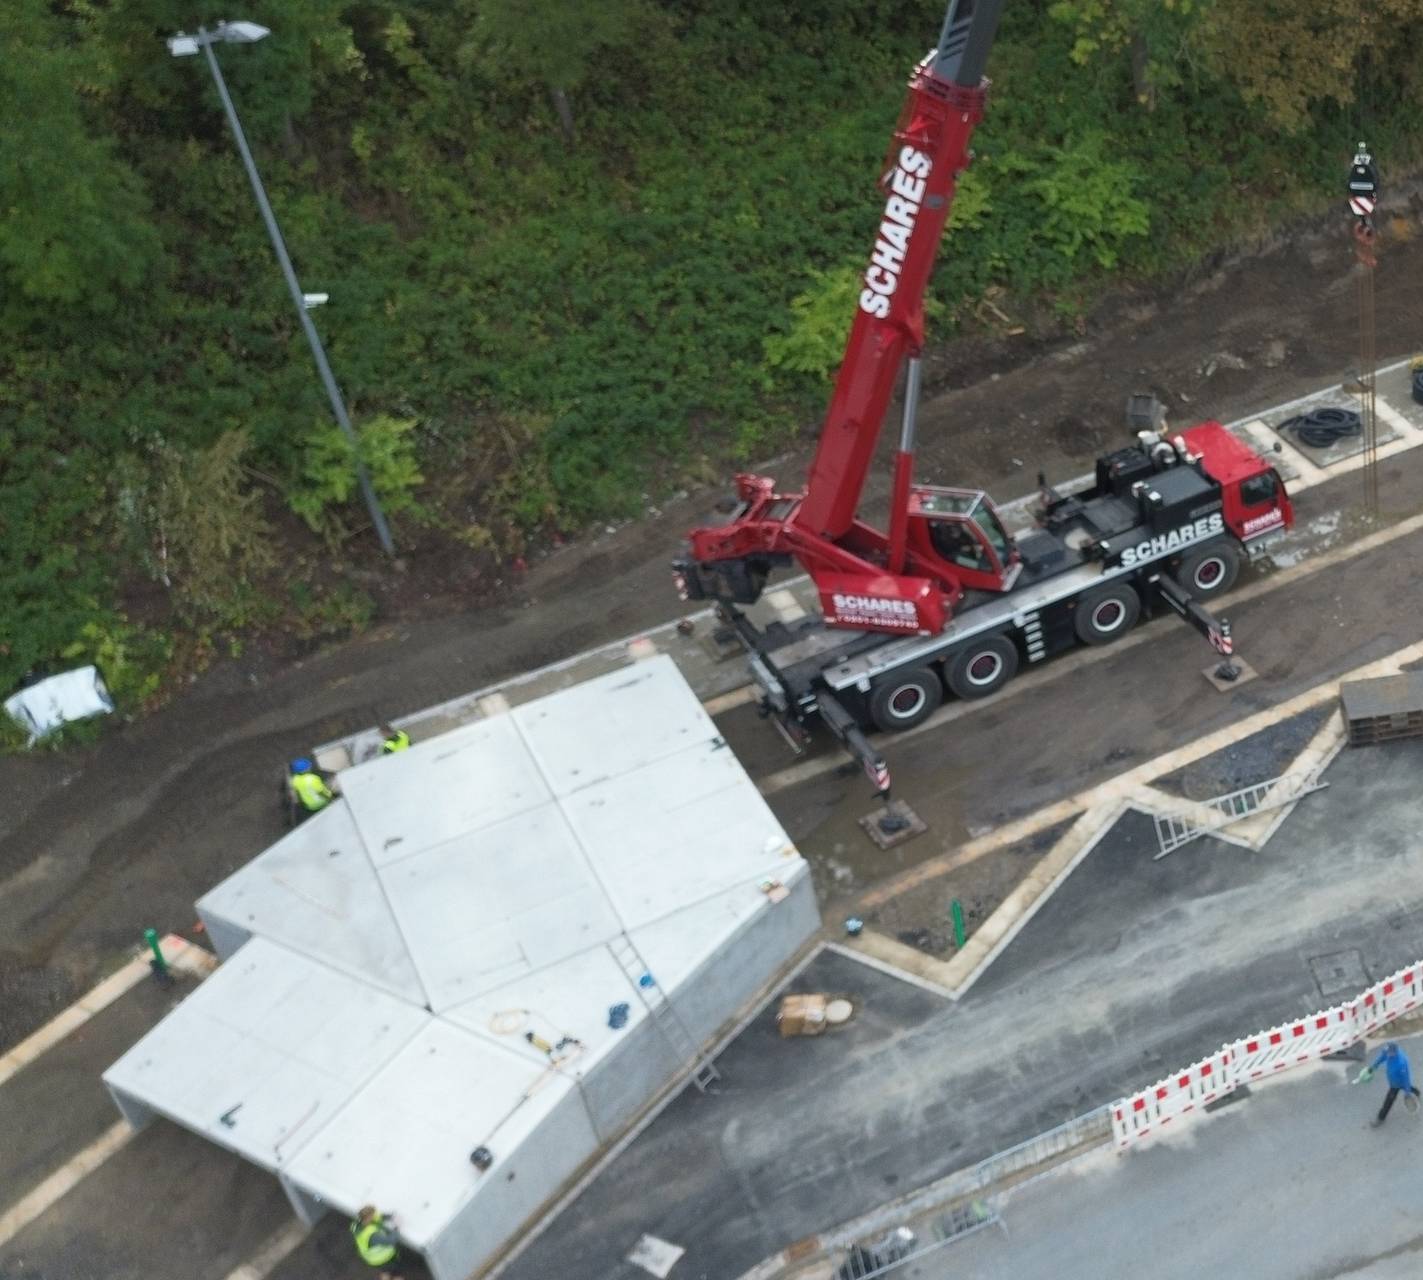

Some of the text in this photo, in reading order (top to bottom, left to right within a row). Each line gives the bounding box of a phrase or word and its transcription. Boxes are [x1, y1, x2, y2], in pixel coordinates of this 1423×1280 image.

[859, 145, 933, 319] SCHARES
[1120, 513, 1223, 566] SCHARES
[833, 594, 916, 614] SCHARES
